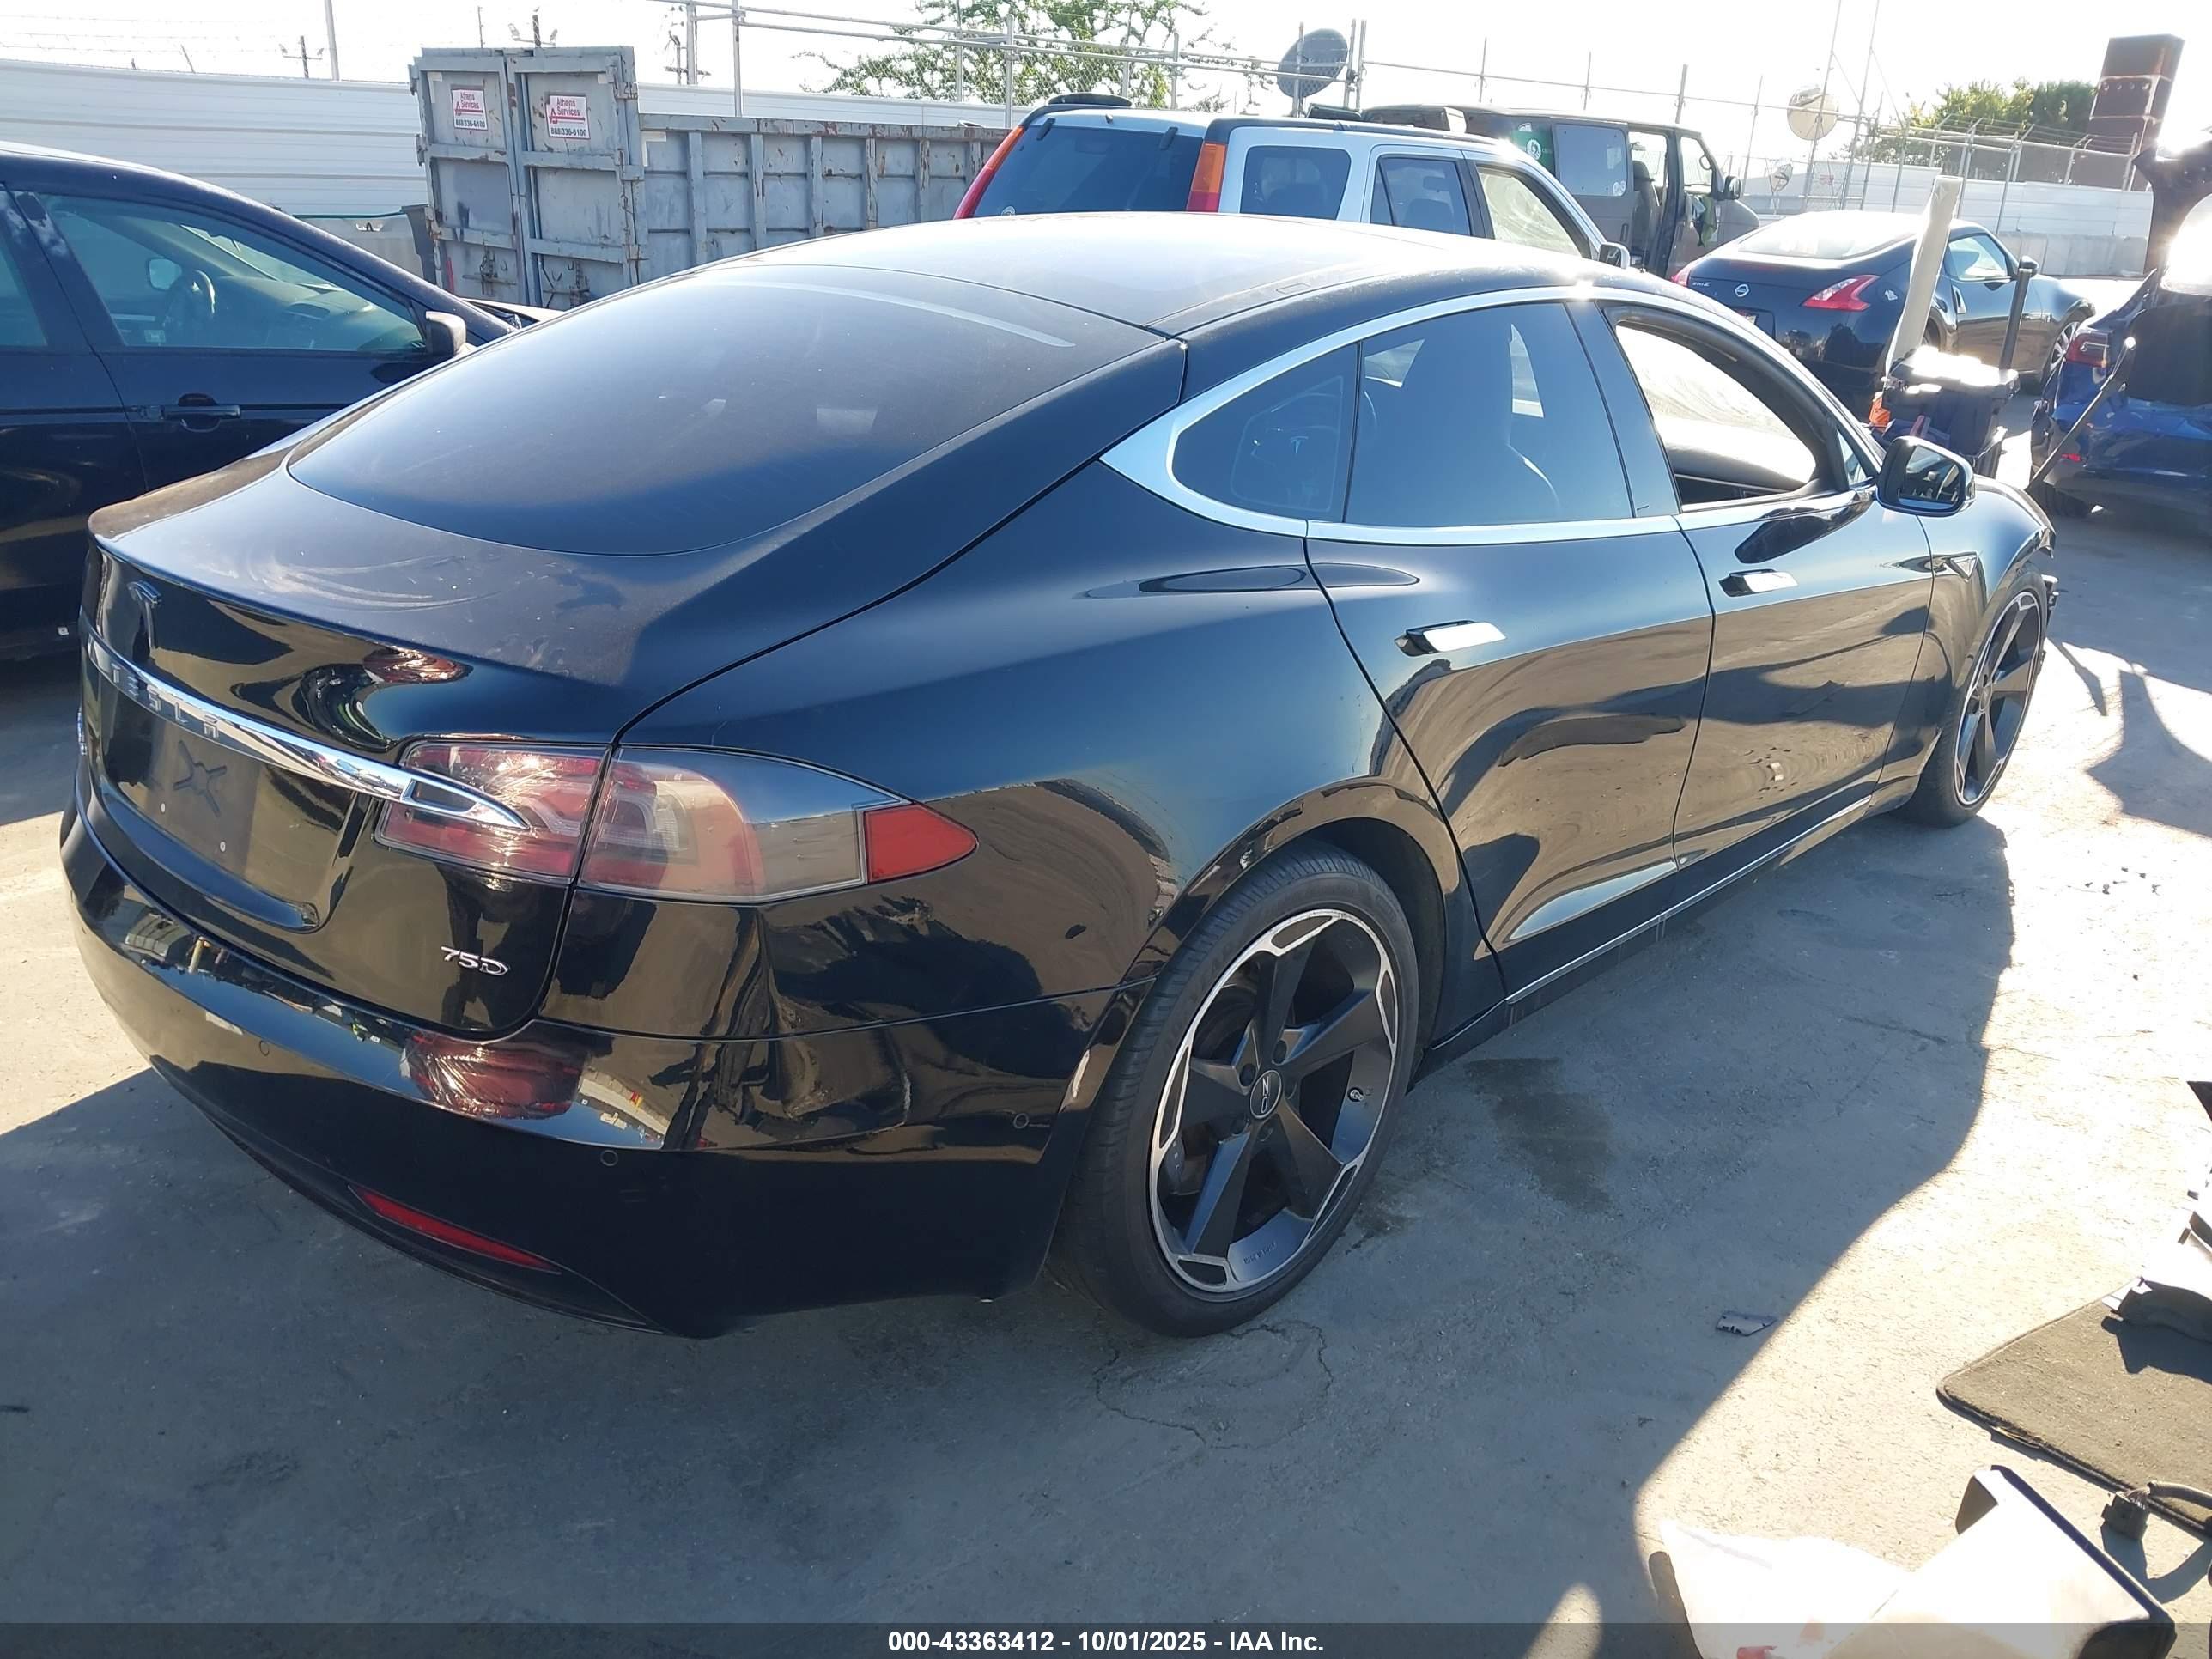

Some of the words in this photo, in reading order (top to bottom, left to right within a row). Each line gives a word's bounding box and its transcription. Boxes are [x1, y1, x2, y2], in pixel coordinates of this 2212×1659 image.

[460, 92, 475, 100] Athens
[461, 100, 480, 109] Services
[556, 97, 576, 106] Athens
[557, 106, 580, 116] Services
[111, 662, 219, 738] TESLA
[441, 945, 508, 975] 75D
